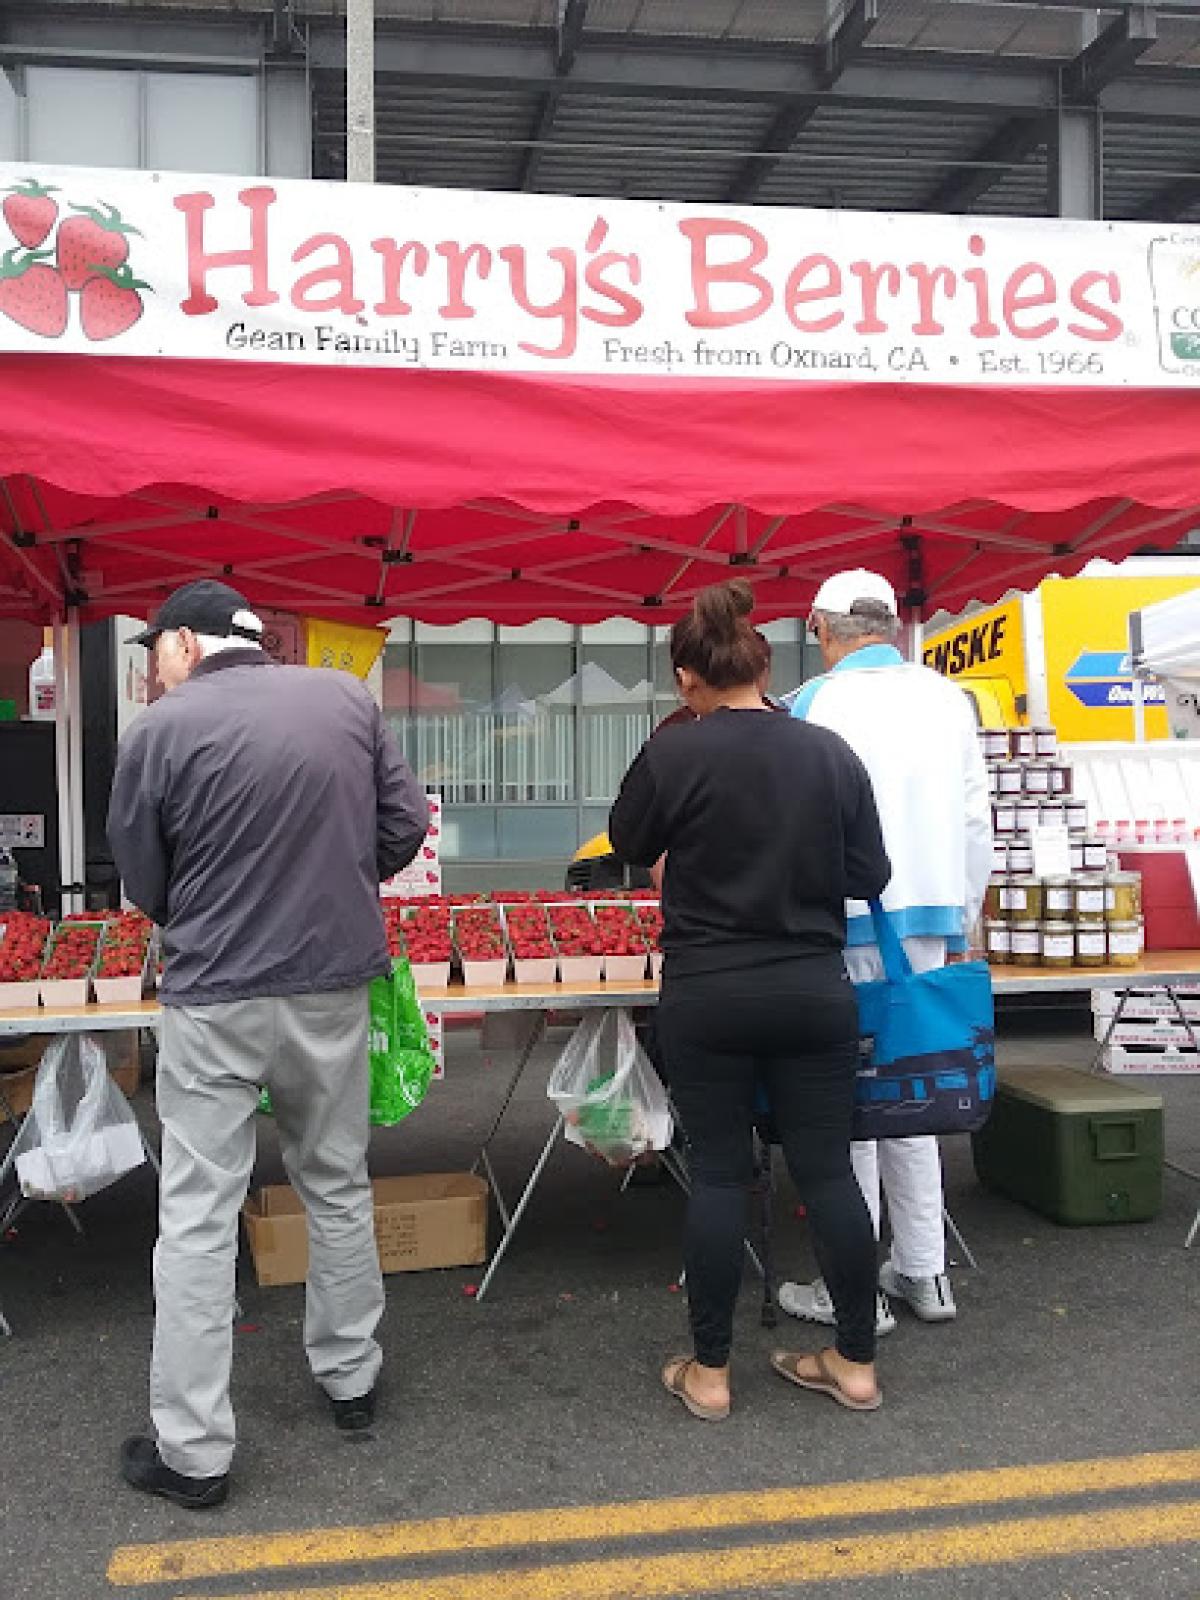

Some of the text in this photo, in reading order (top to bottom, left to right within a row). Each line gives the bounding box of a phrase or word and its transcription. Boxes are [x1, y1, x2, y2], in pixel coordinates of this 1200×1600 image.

[174, 186, 1124, 357] Harry's Berries
[225, 322, 508, 363] Gean Family Farm
[602, 337, 684, 363] Fresh
[693, 338, 763, 366] from
[770, 340, 879, 372] Oxnard,
[887, 346, 930, 372] CA
[1037, 350, 1105, 375] 1966
